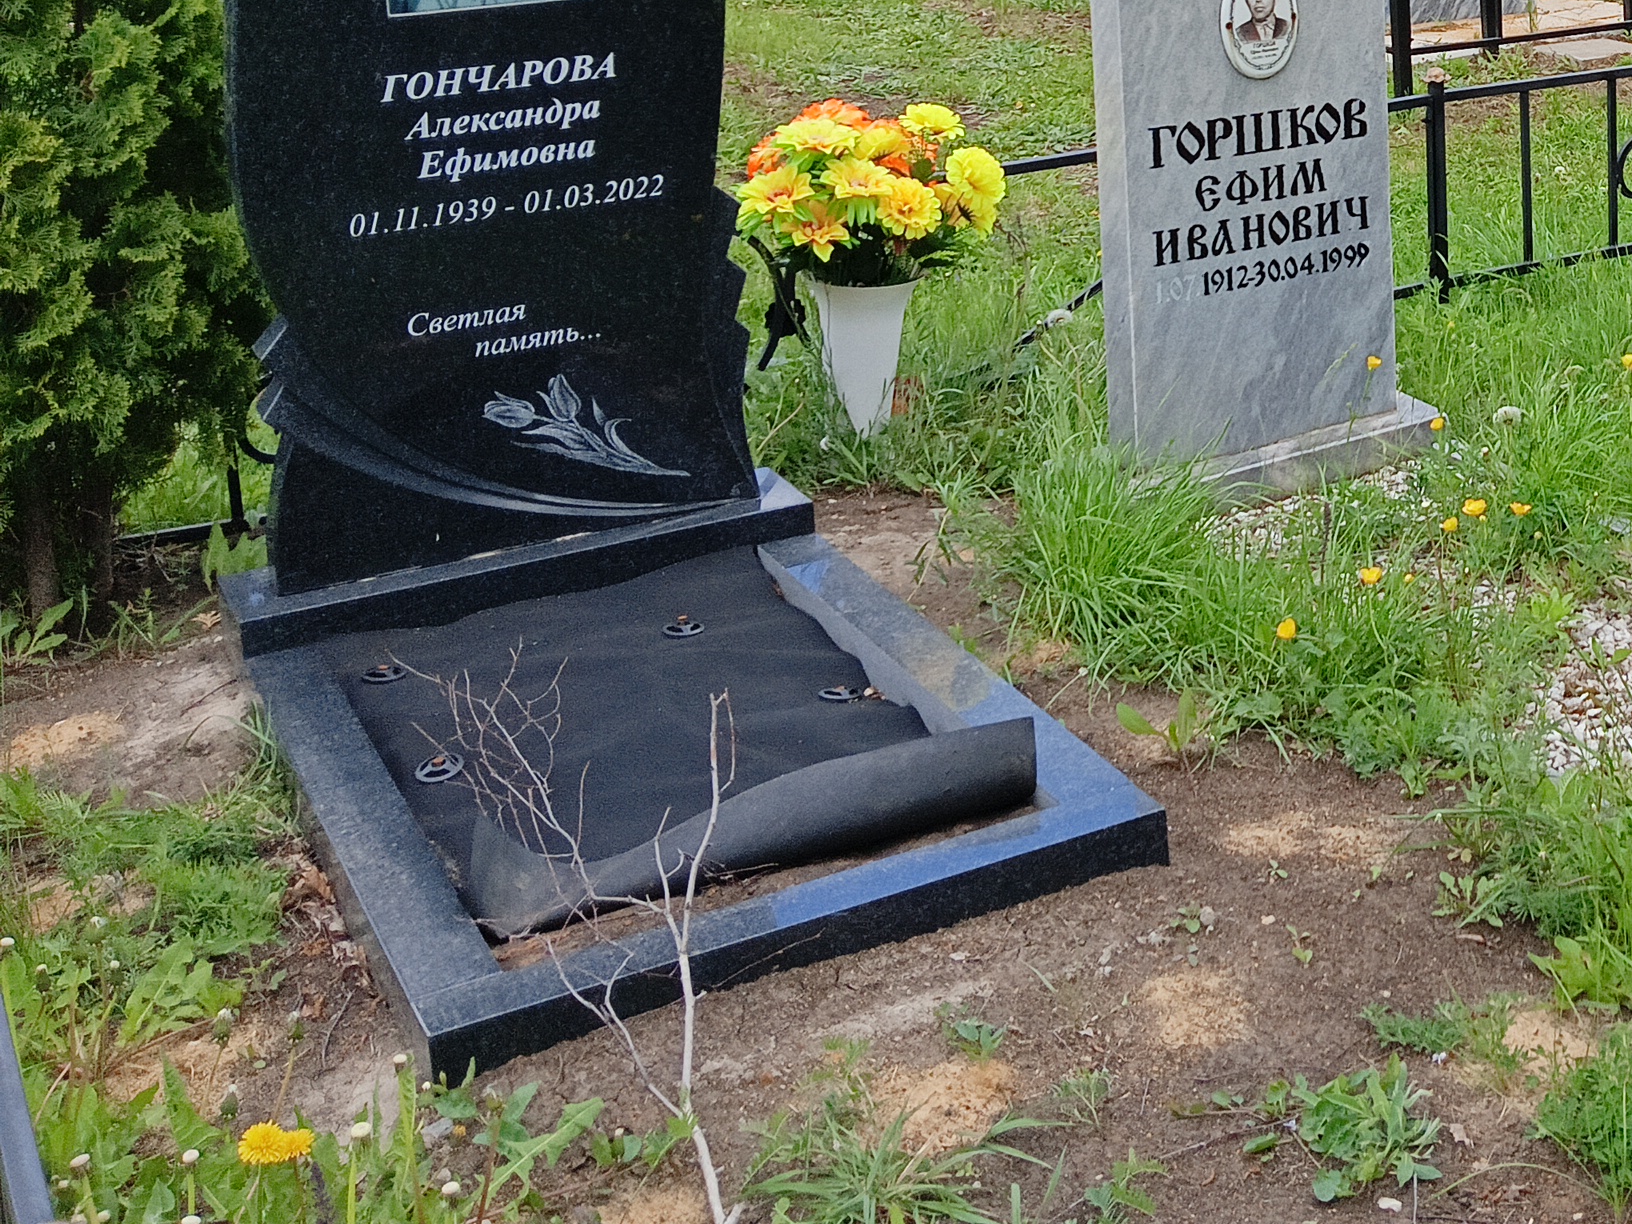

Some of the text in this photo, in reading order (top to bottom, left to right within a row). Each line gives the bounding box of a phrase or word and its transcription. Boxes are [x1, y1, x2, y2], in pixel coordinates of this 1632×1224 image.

[380, 51, 618, 103] ГОНЧАРОВА
[404, 97, 601, 140] Александра
[1148, 98, 1368, 170] ГОРШКОВ
[417, 138, 596, 182] Ефимовна
[1195, 158, 1327, 212] ЕФИМ
[350, 196, 497, 238] 01.11.1939
[524, 174, 664, 214] 01.03.2022
[1152, 196, 1370, 267] ИВАНОВИЧ
[407, 304, 526, 337] Светлая
[475, 327, 602, 358] память...
